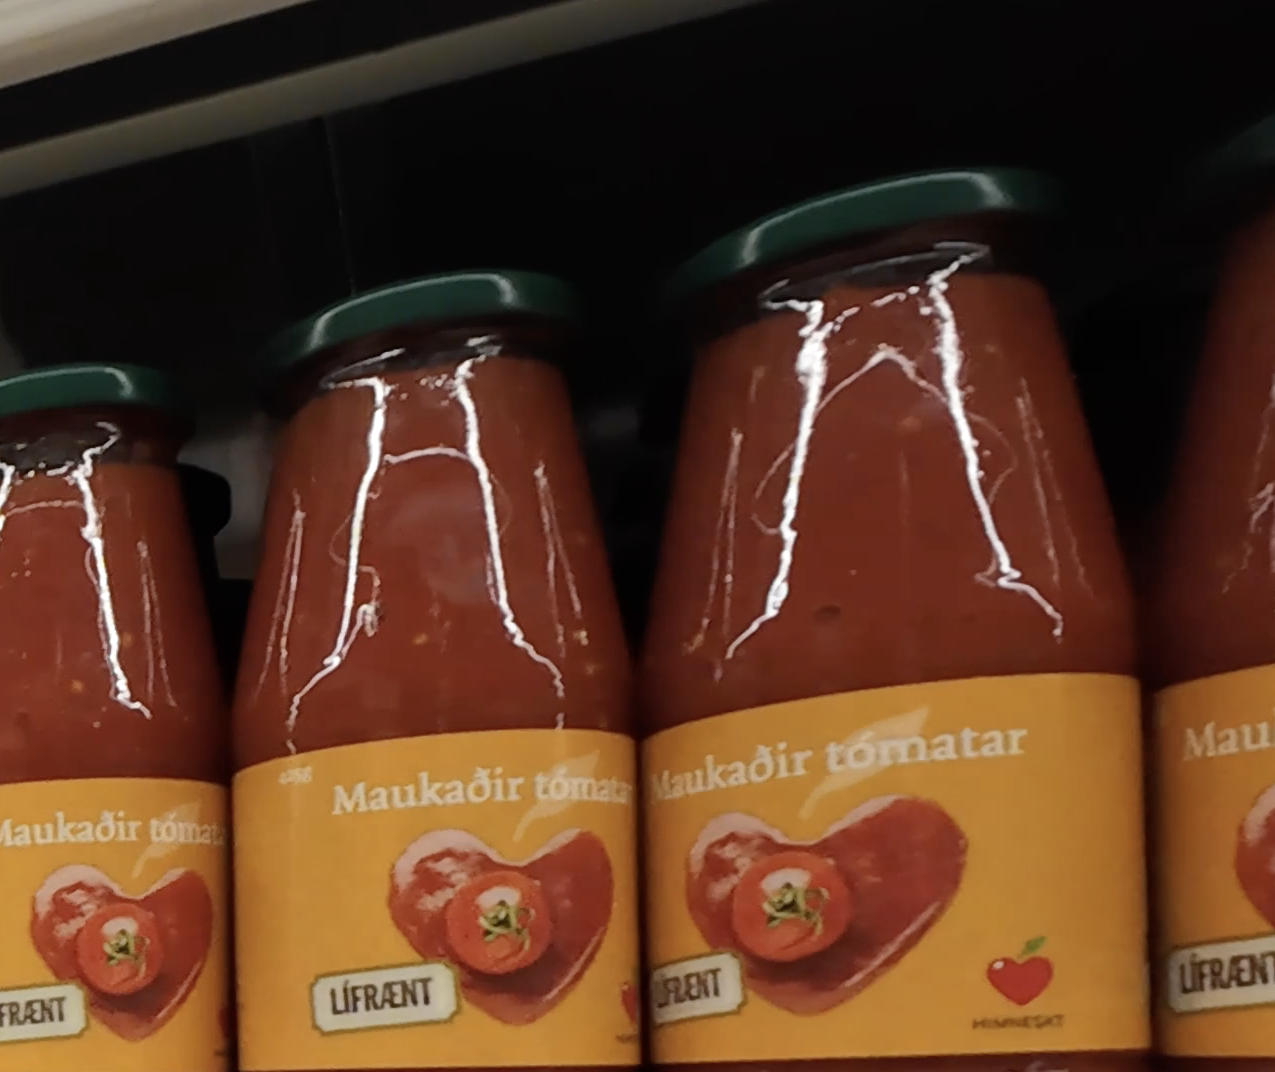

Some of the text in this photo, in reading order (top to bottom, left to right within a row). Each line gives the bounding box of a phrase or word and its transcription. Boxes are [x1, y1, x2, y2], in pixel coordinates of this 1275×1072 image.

[825, 725, 1028, 774] tómatar
[1183, 719, 1275, 762] Mau
[332, 767, 524, 815] Maukaðir
[330, 976, 433, 1016] LÍFRÆNT
